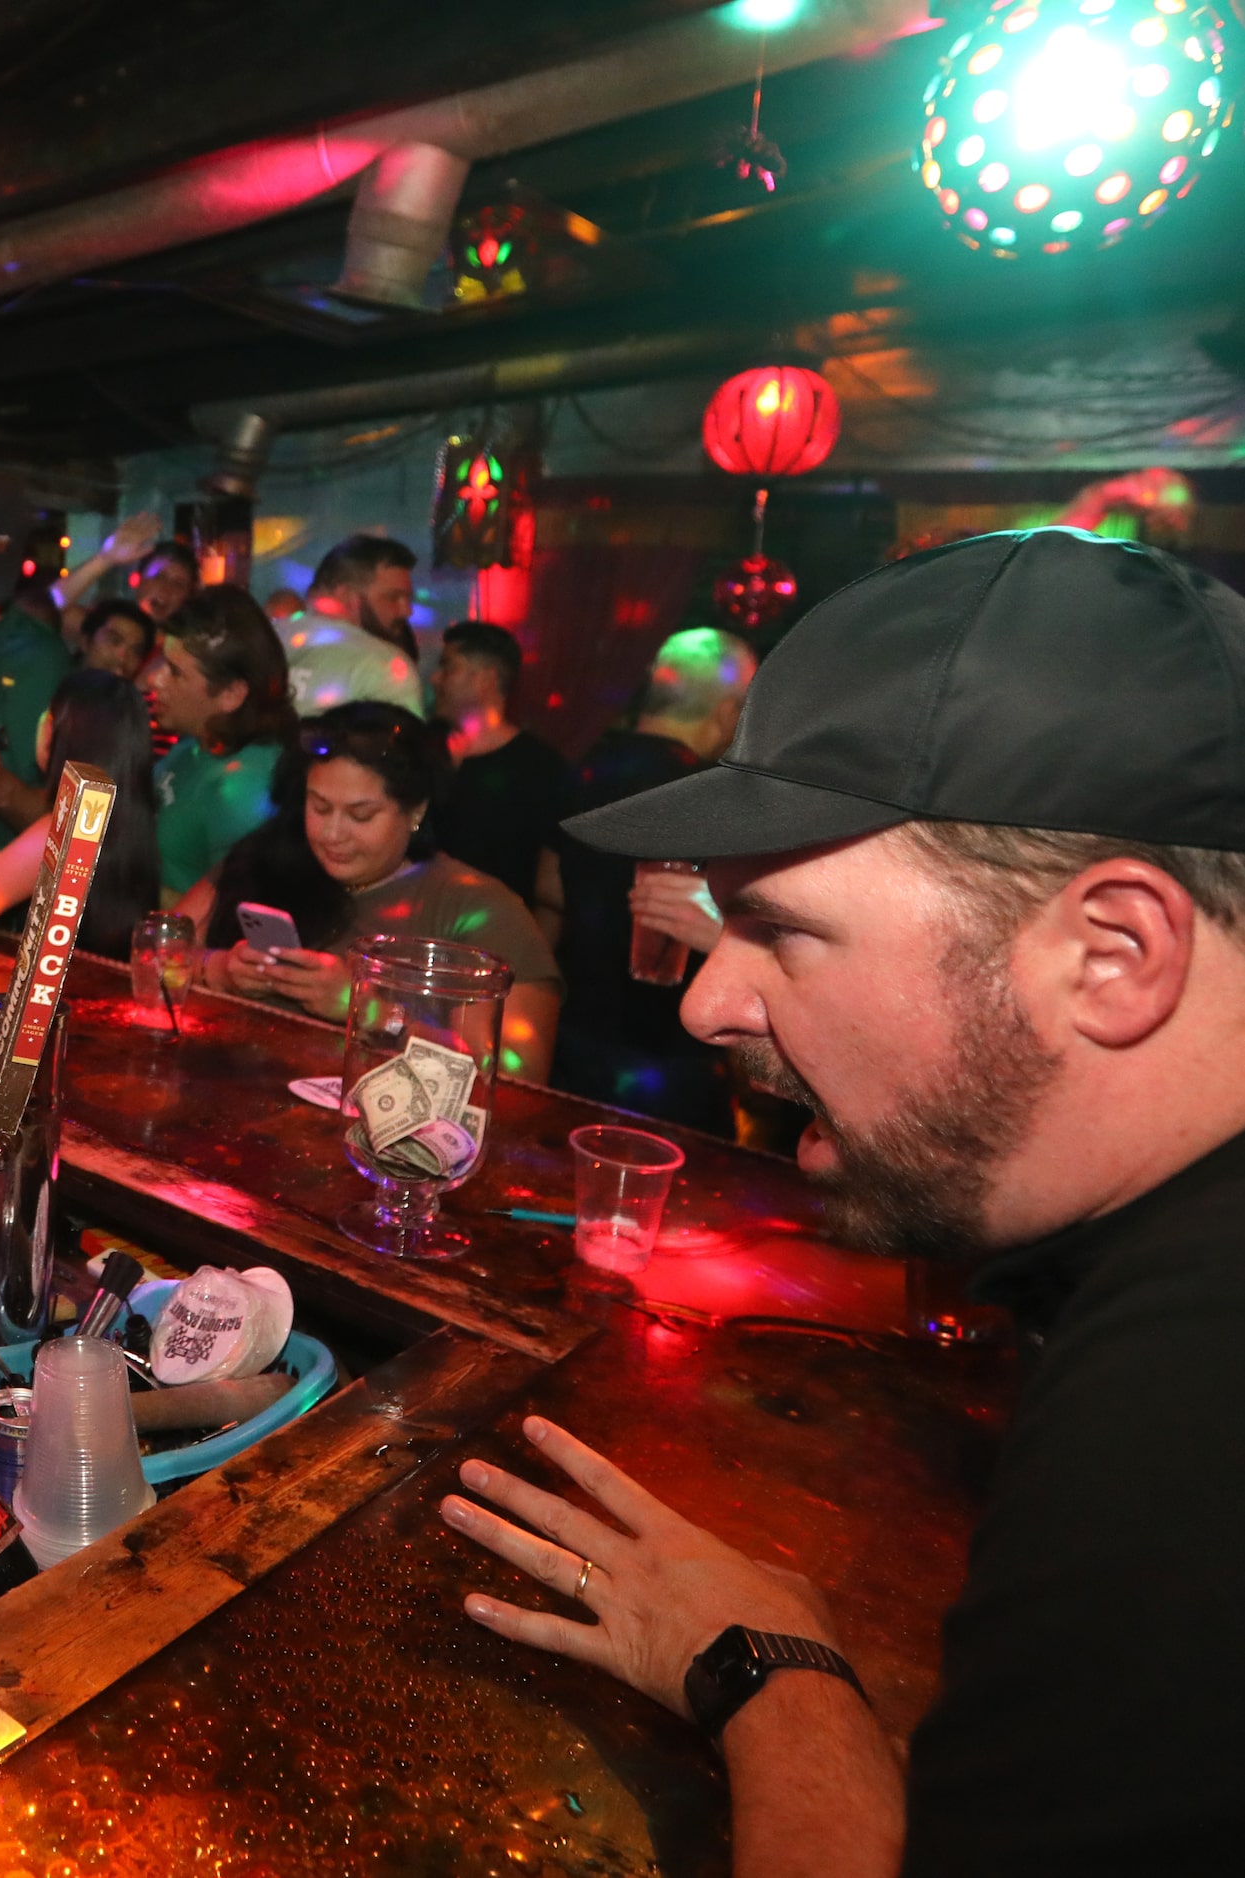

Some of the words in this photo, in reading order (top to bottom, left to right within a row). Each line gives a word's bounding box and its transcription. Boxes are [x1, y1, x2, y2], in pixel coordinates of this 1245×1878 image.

[66, 863, 89, 872] TEXAS
[65, 869, 88, 878] STYLE
[29, 894, 79, 1007] BOCK
[23, 1023, 46, 1032] AMBER
[21, 1029, 44, 1038] LAGER
